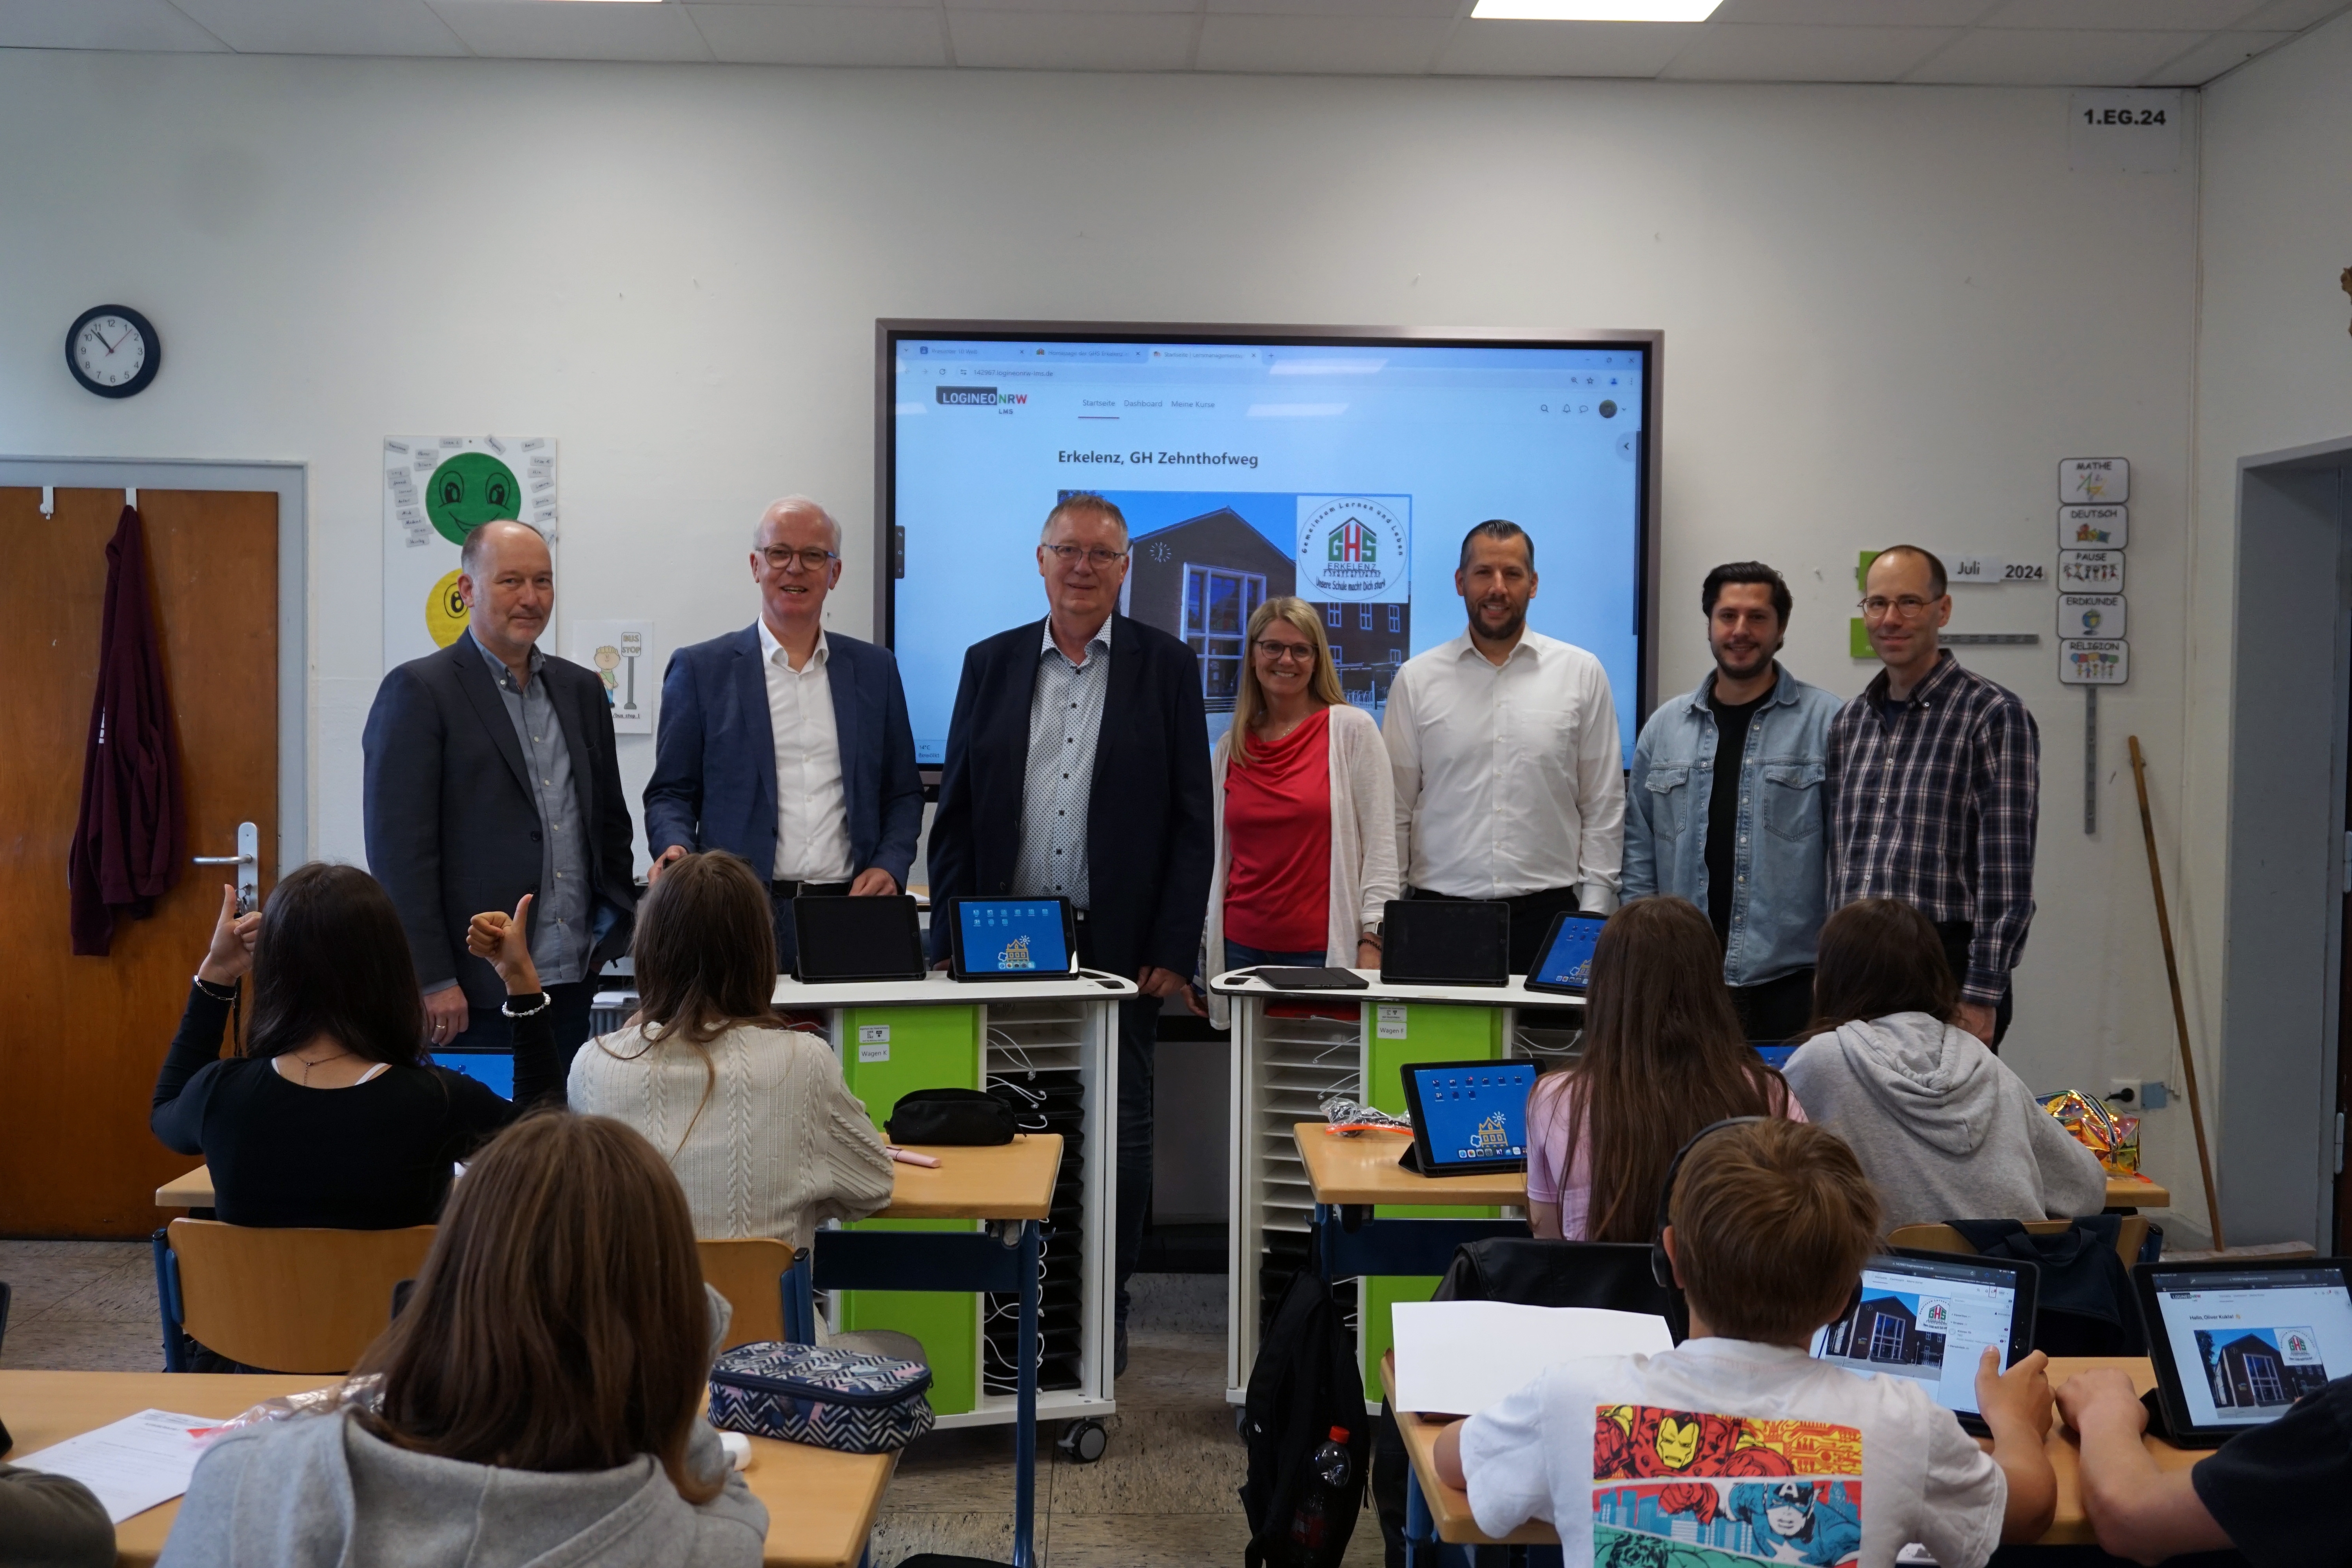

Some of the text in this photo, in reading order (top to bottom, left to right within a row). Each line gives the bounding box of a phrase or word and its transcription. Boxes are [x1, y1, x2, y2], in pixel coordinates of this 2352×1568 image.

[2084, 109, 2167, 125] 1.EG.24
[107, 319, 116, 327] 12
[137, 347, 143, 356] 3
[942, 392, 1027, 405] LOGINEO NRW
[1058, 450, 1259, 469] Erkelenz, GH Zehnthofweg
[2076, 461, 2112, 470] MATHE
[2070, 510, 2118, 519] DEUTSCH
[1301, 502, 1404, 556] Gemeinsam Lernen und Leben
[1328, 523, 1377, 562] GHS
[2076, 552, 2107, 561] PAUSE
[1957, 561, 2043, 578] Juli 2024
[1316, 575, 1331, 589] Unsere
[1332, 580, 1347, 591] Schule
[1348, 581, 1363, 591] macht
[1363, 581, 1374, 591] Dich
[2066, 597, 2118, 606] ERDKUNDE
[2070, 642, 2120, 651] RELIGION
[1928, 1306, 1947, 1320] GHS
[2288, 1337, 2307, 1351] GHS
[1779, 1483, 1799, 1499] A
